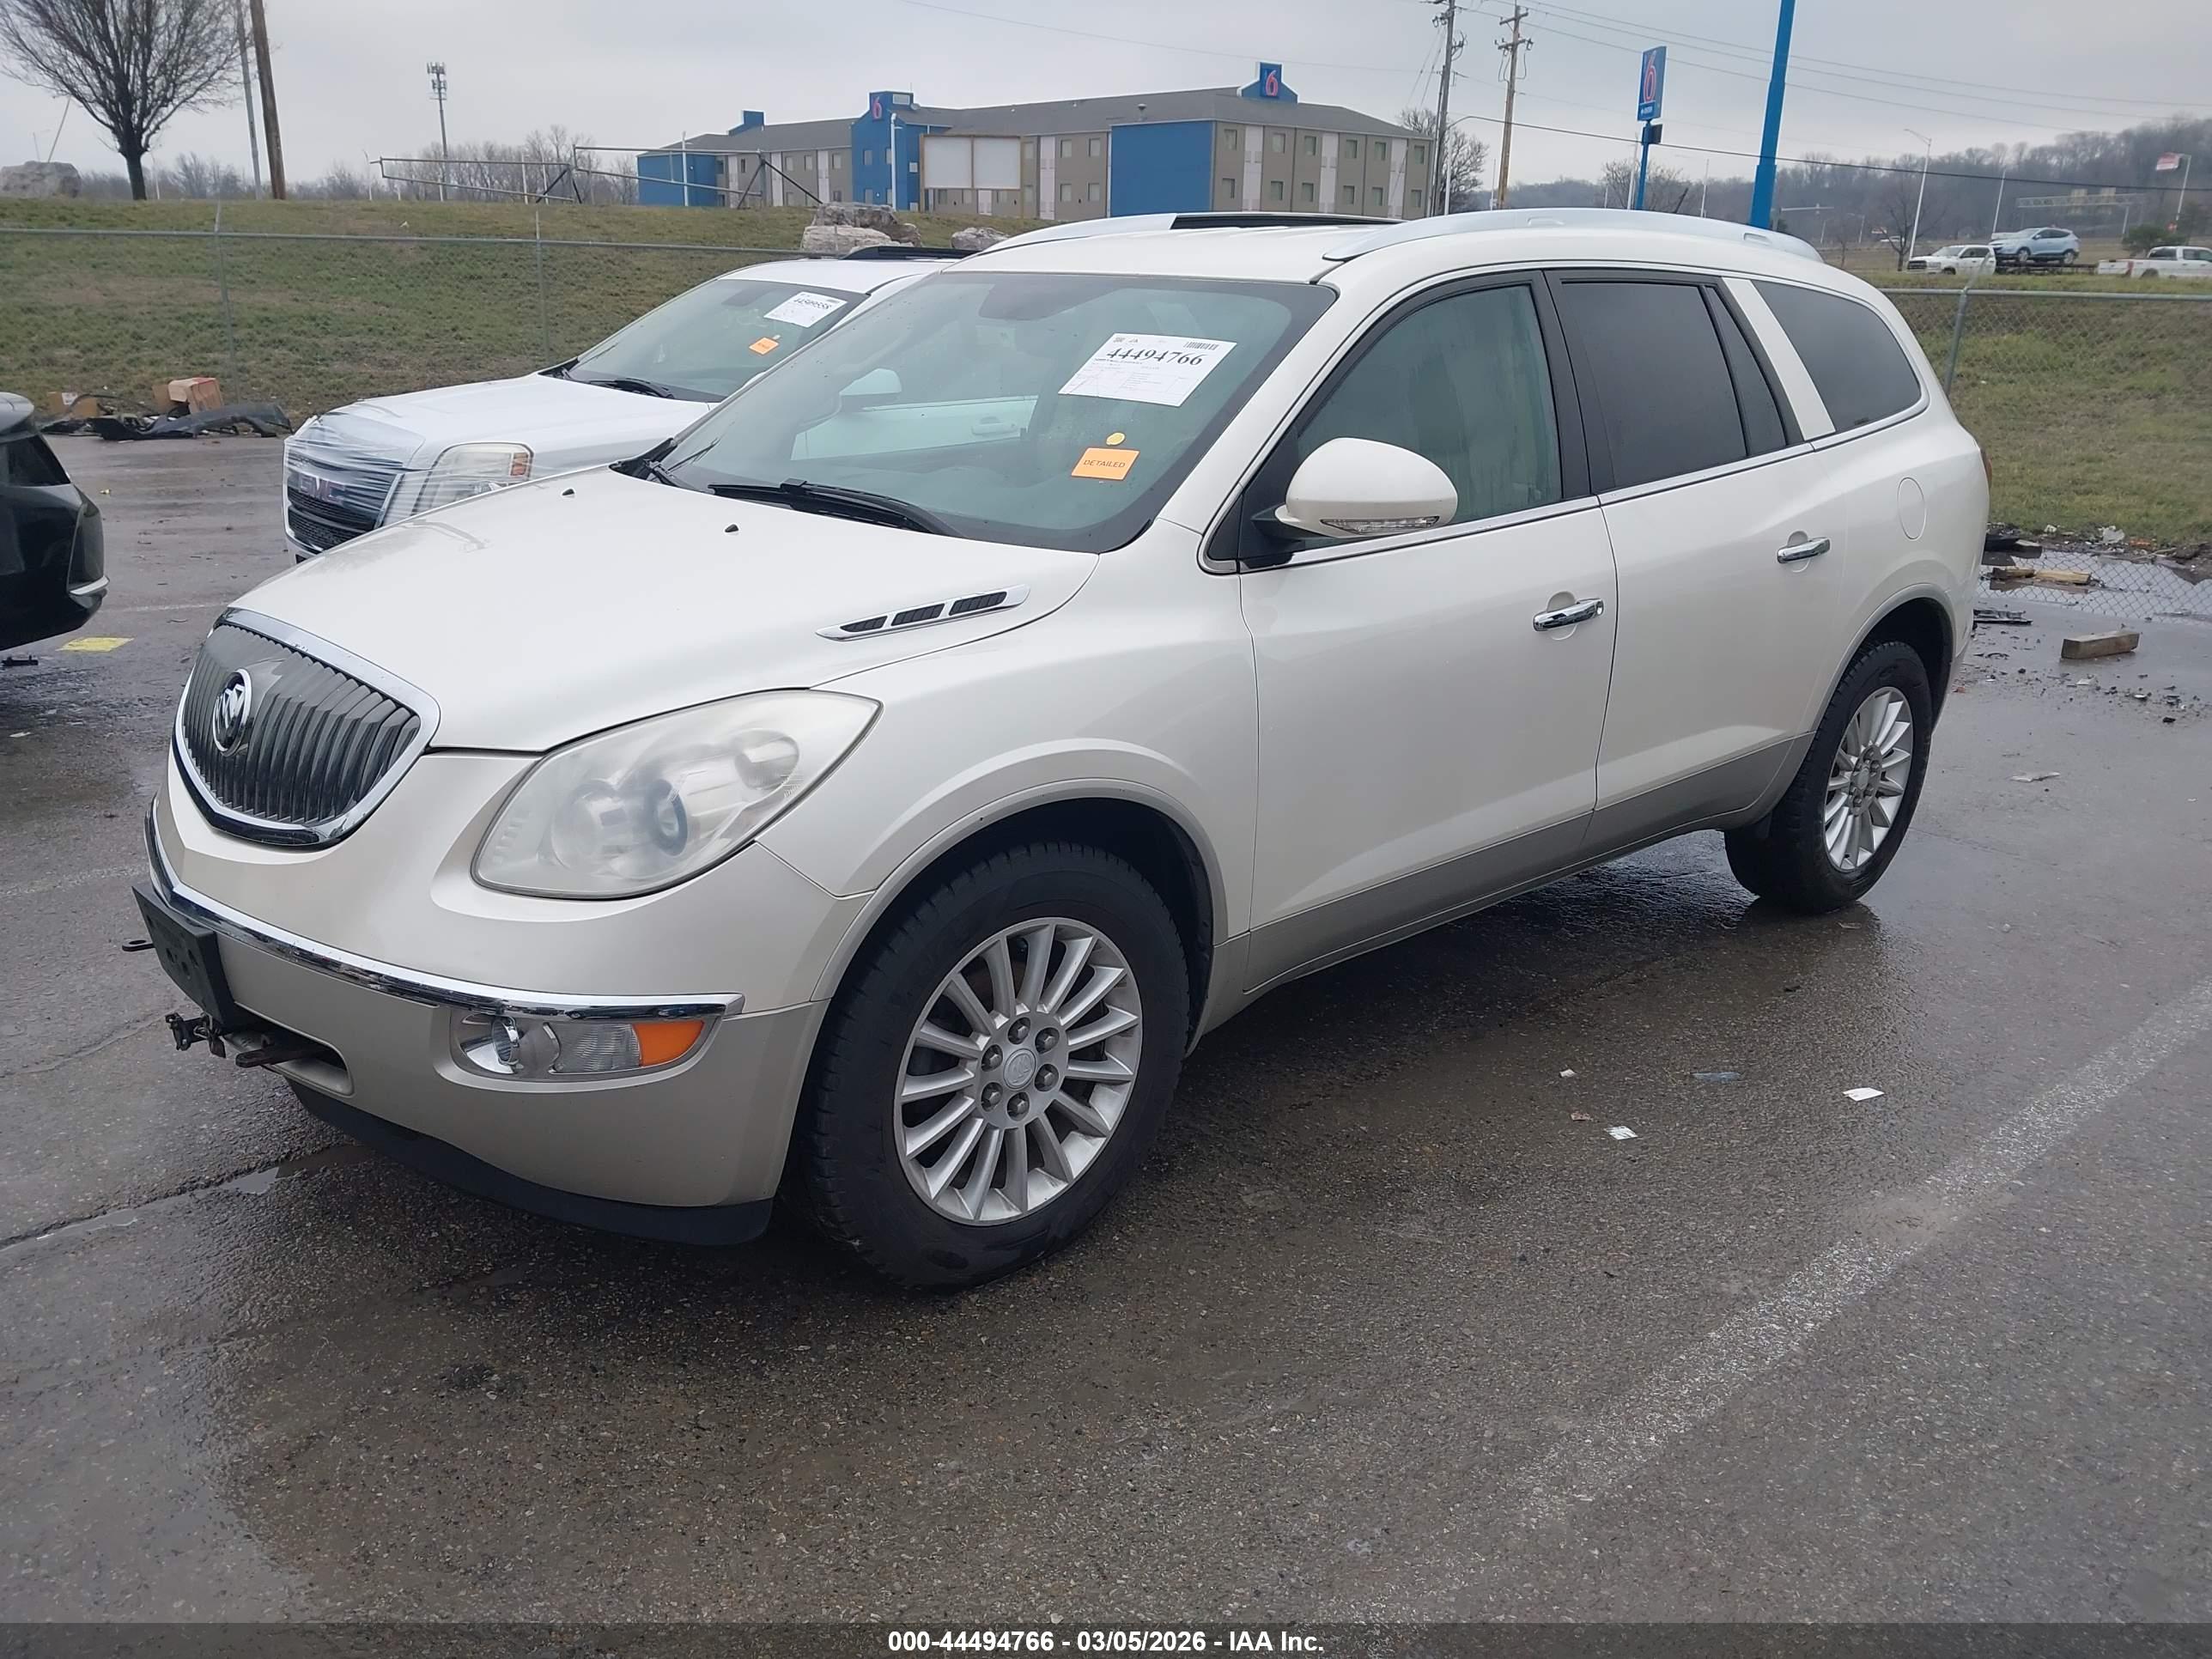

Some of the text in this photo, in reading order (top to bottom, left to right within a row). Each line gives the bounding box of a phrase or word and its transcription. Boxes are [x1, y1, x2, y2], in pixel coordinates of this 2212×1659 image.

[1266, 70, 1279, 97] 6
[1644, 50, 1656, 103] 6
[872, 95, 883, 119] 6
[1106, 347, 1207, 367] 44494766
[1083, 459, 1126, 468] DETAILED
[298, 471, 346, 506] GMC
